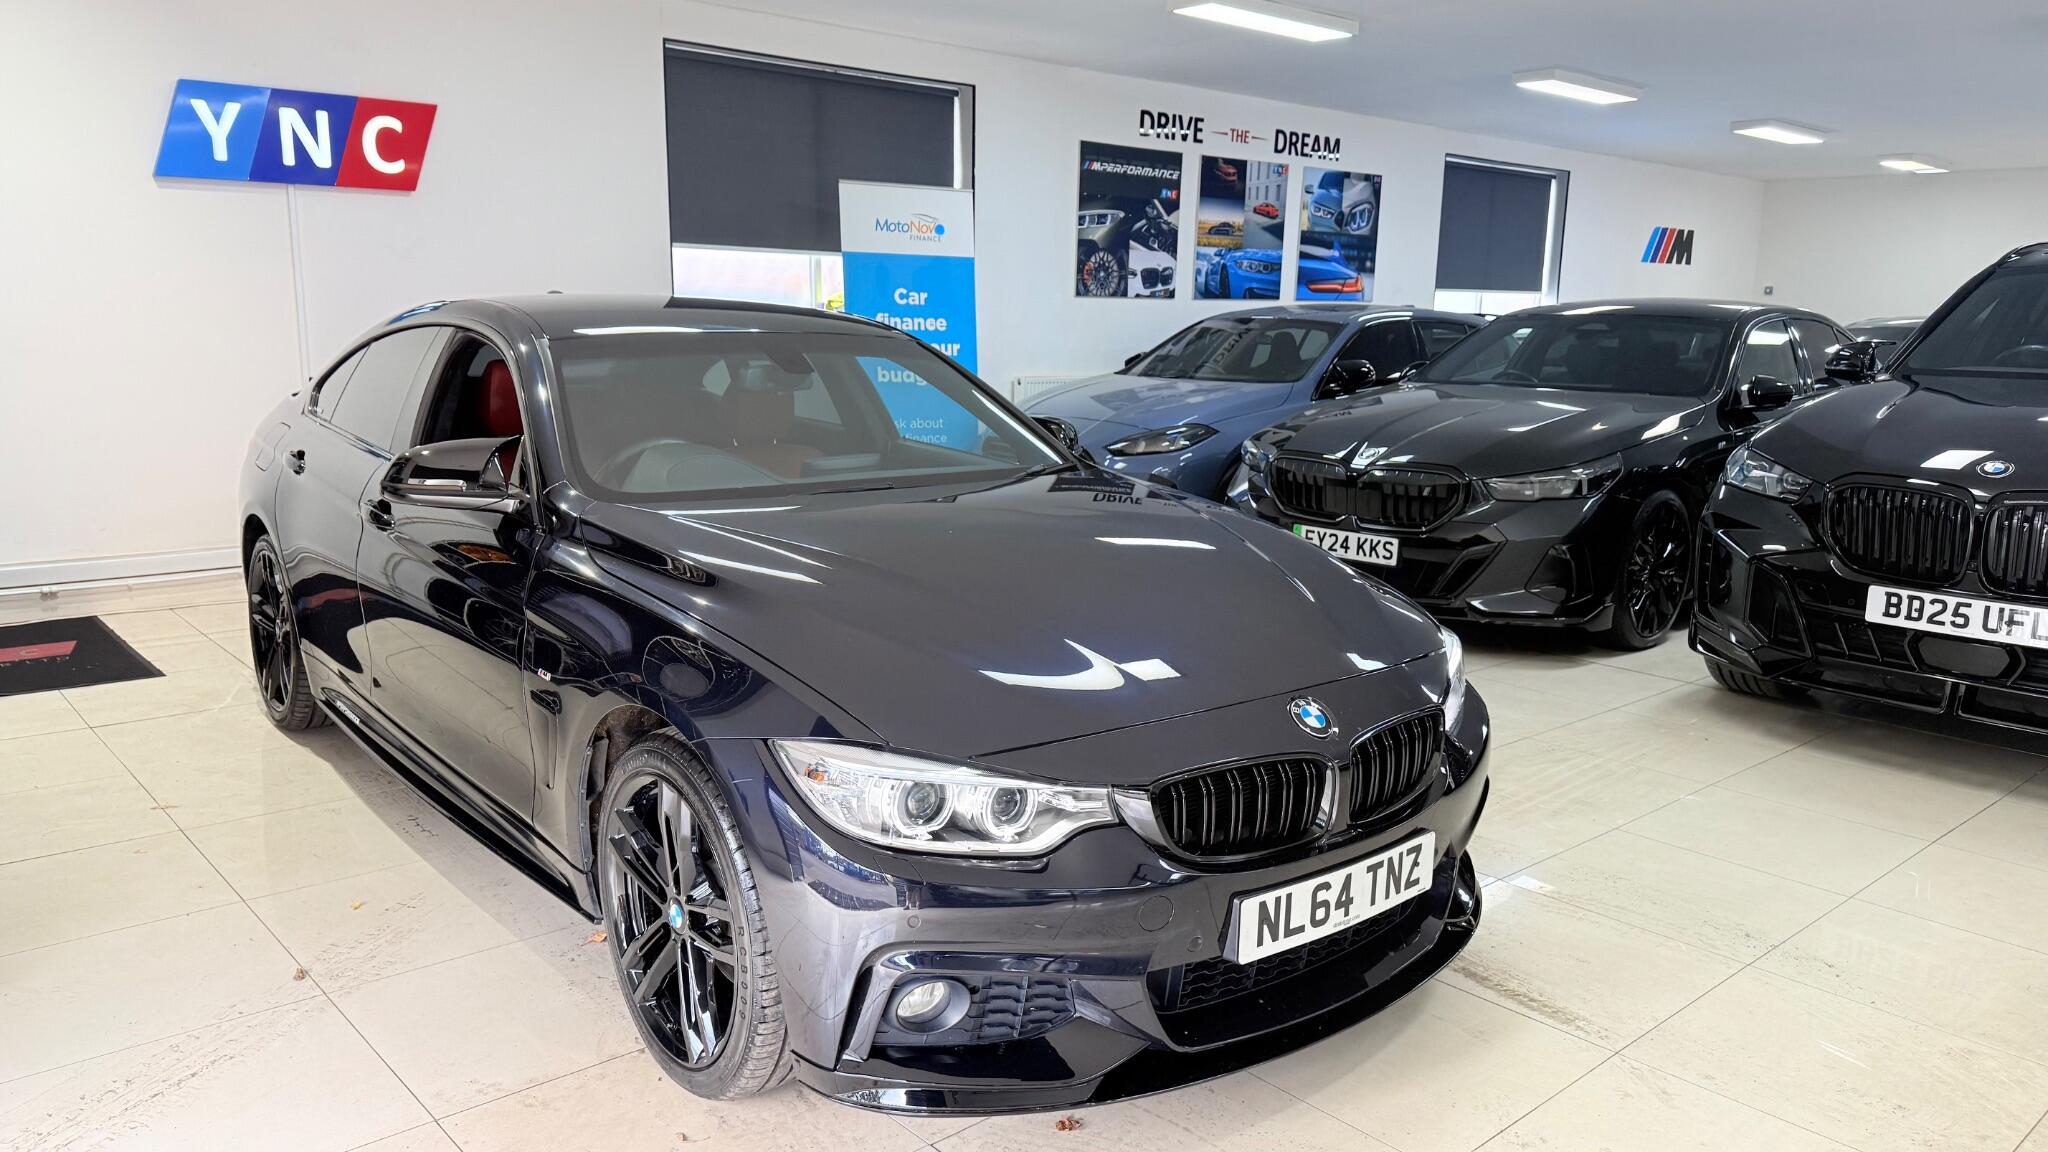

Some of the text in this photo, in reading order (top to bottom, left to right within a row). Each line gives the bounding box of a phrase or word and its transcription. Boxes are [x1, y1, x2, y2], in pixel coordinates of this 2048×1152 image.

[190, 98, 405, 174] YNC
[1139, 109, 1341, 161] DRIVE THE DREAM
[909, 234, 942, 243] FINANCE
[894, 287, 928, 305] Car
[876, 312, 947, 331] finance
[910, 418, 943, 428] about
[1356, 536, 1394, 560] KKS
[1882, 591, 1972, 630] BD25
[1257, 843, 1422, 948] NL64 TNZ
